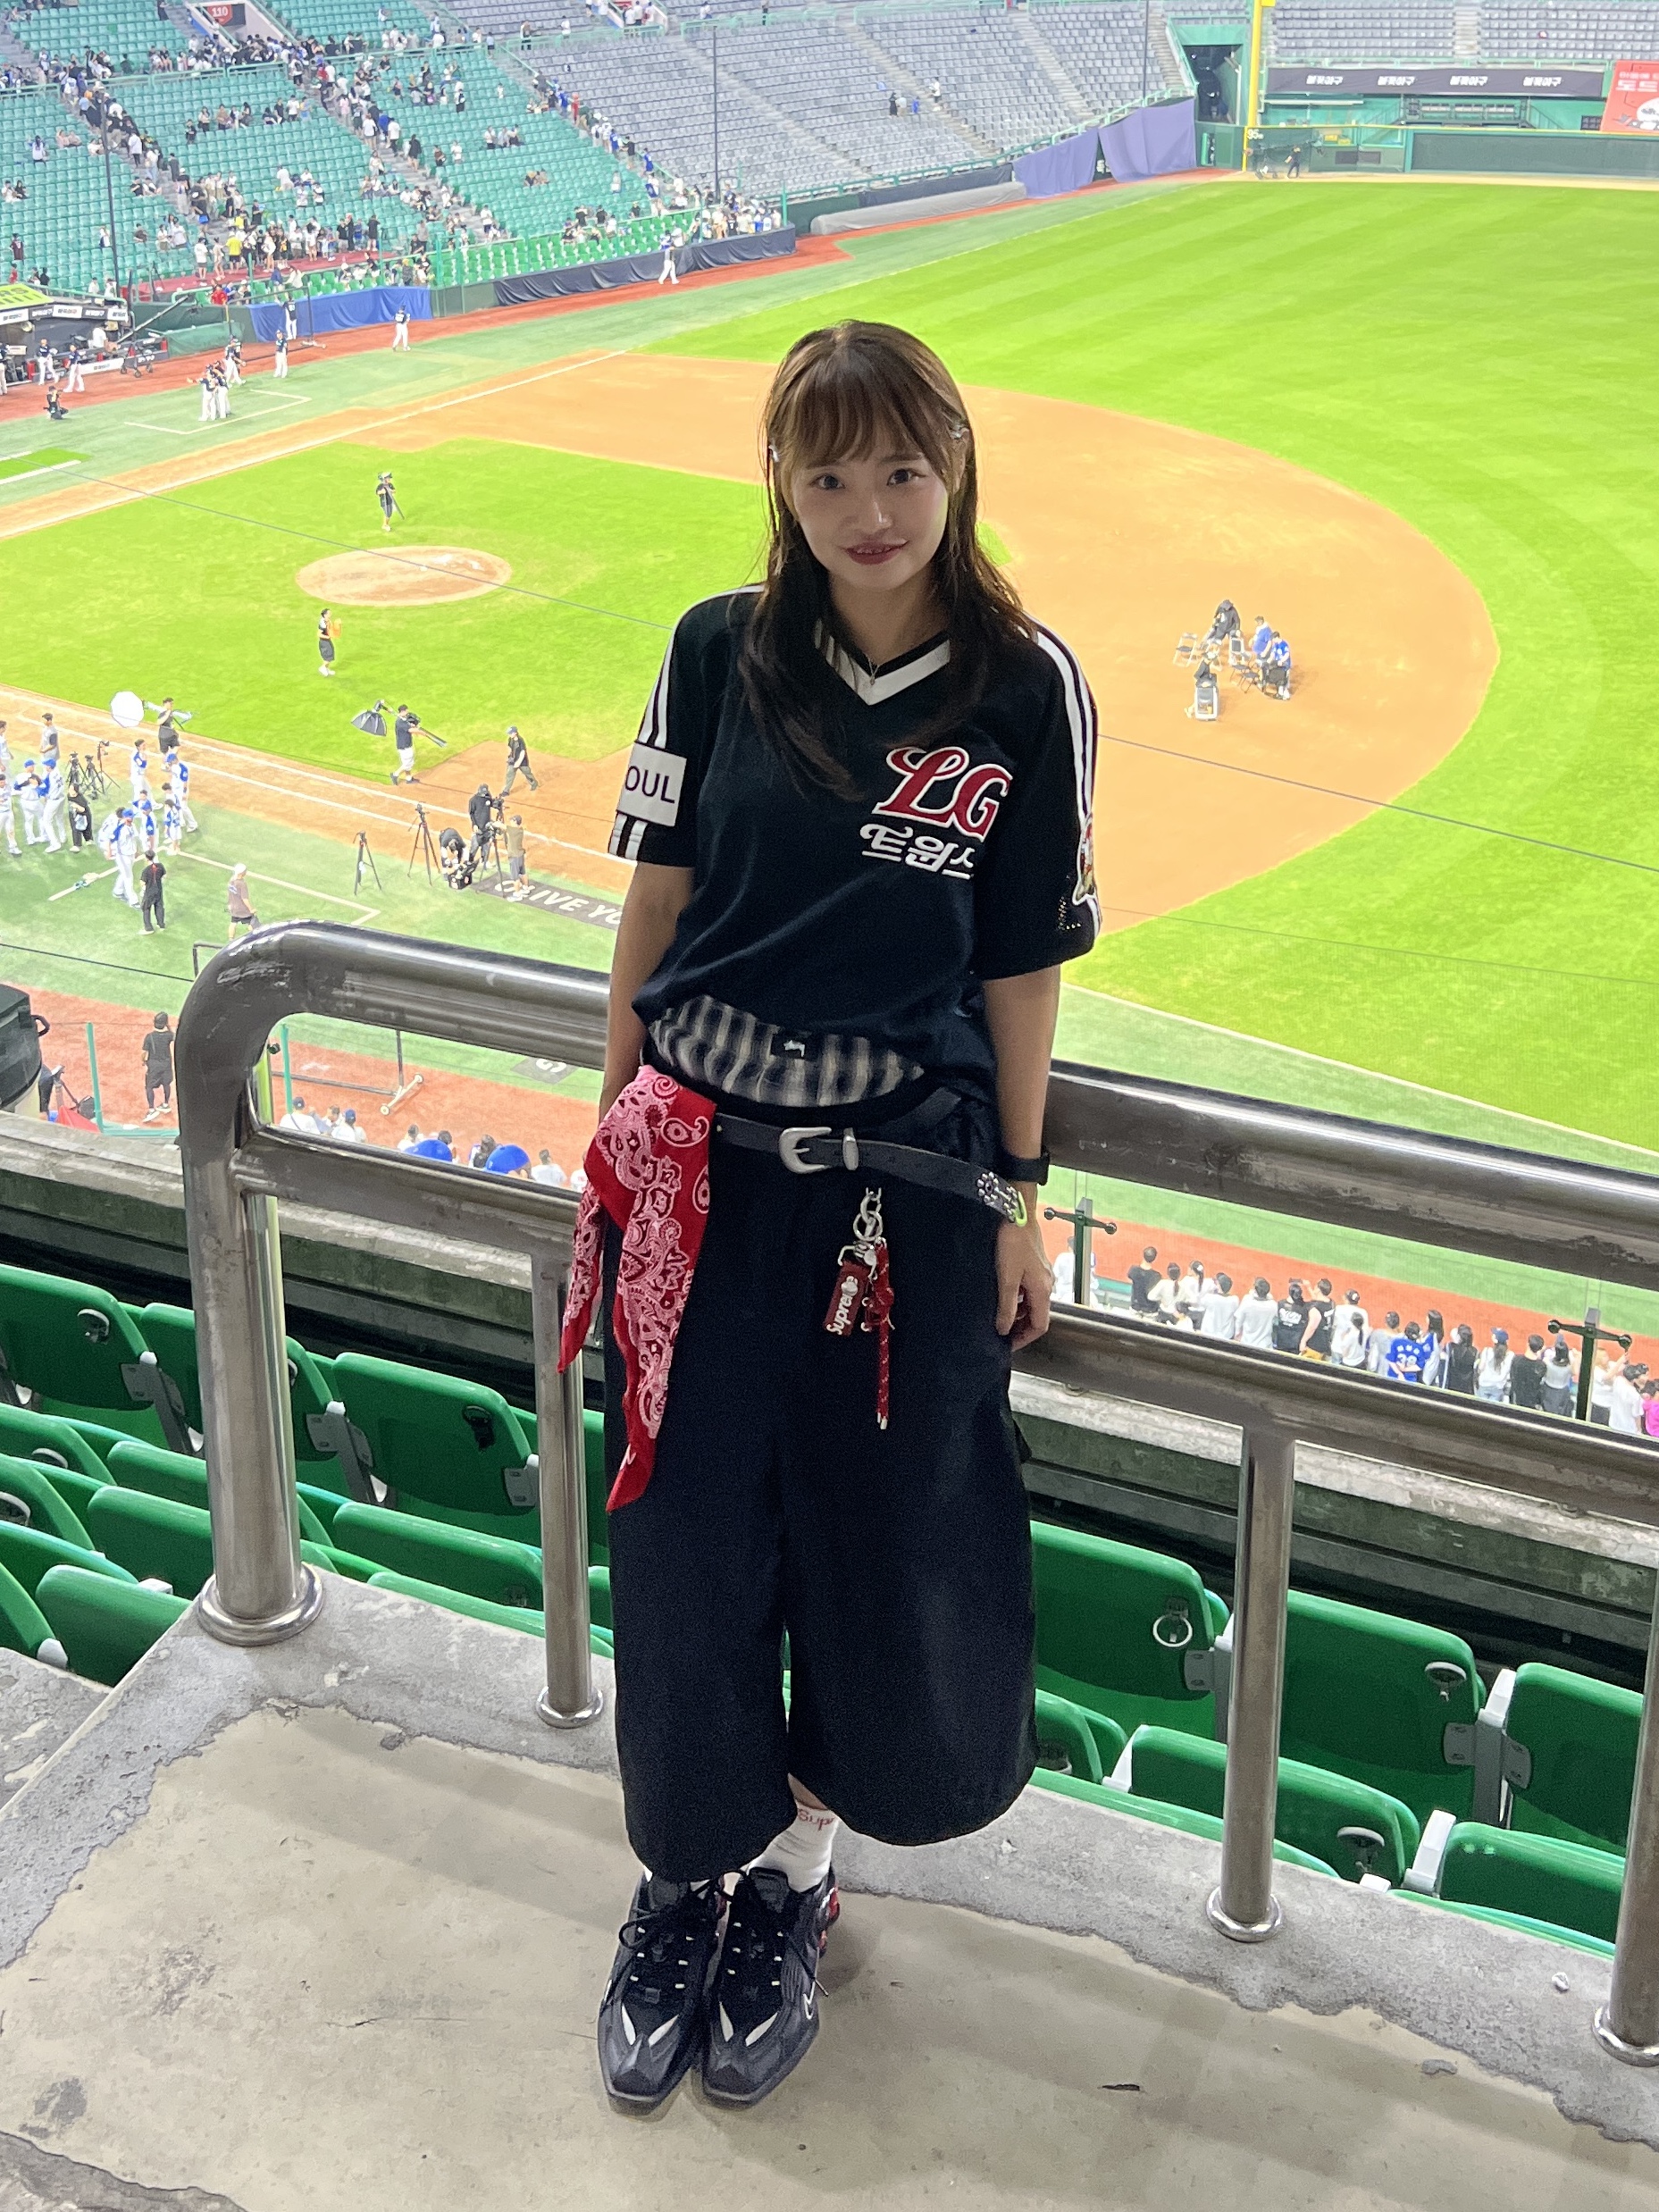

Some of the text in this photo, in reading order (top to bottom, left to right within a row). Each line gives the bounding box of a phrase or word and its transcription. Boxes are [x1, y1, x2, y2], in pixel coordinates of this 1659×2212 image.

[211, 6, 229, 18] 110
[624, 766, 675, 804] OUL
[871, 746, 1013, 842] LG
[859, 823, 976, 880] 트윈스
[494, 880, 590, 912] OIVE
[826, 1293, 854, 1336] Supre
